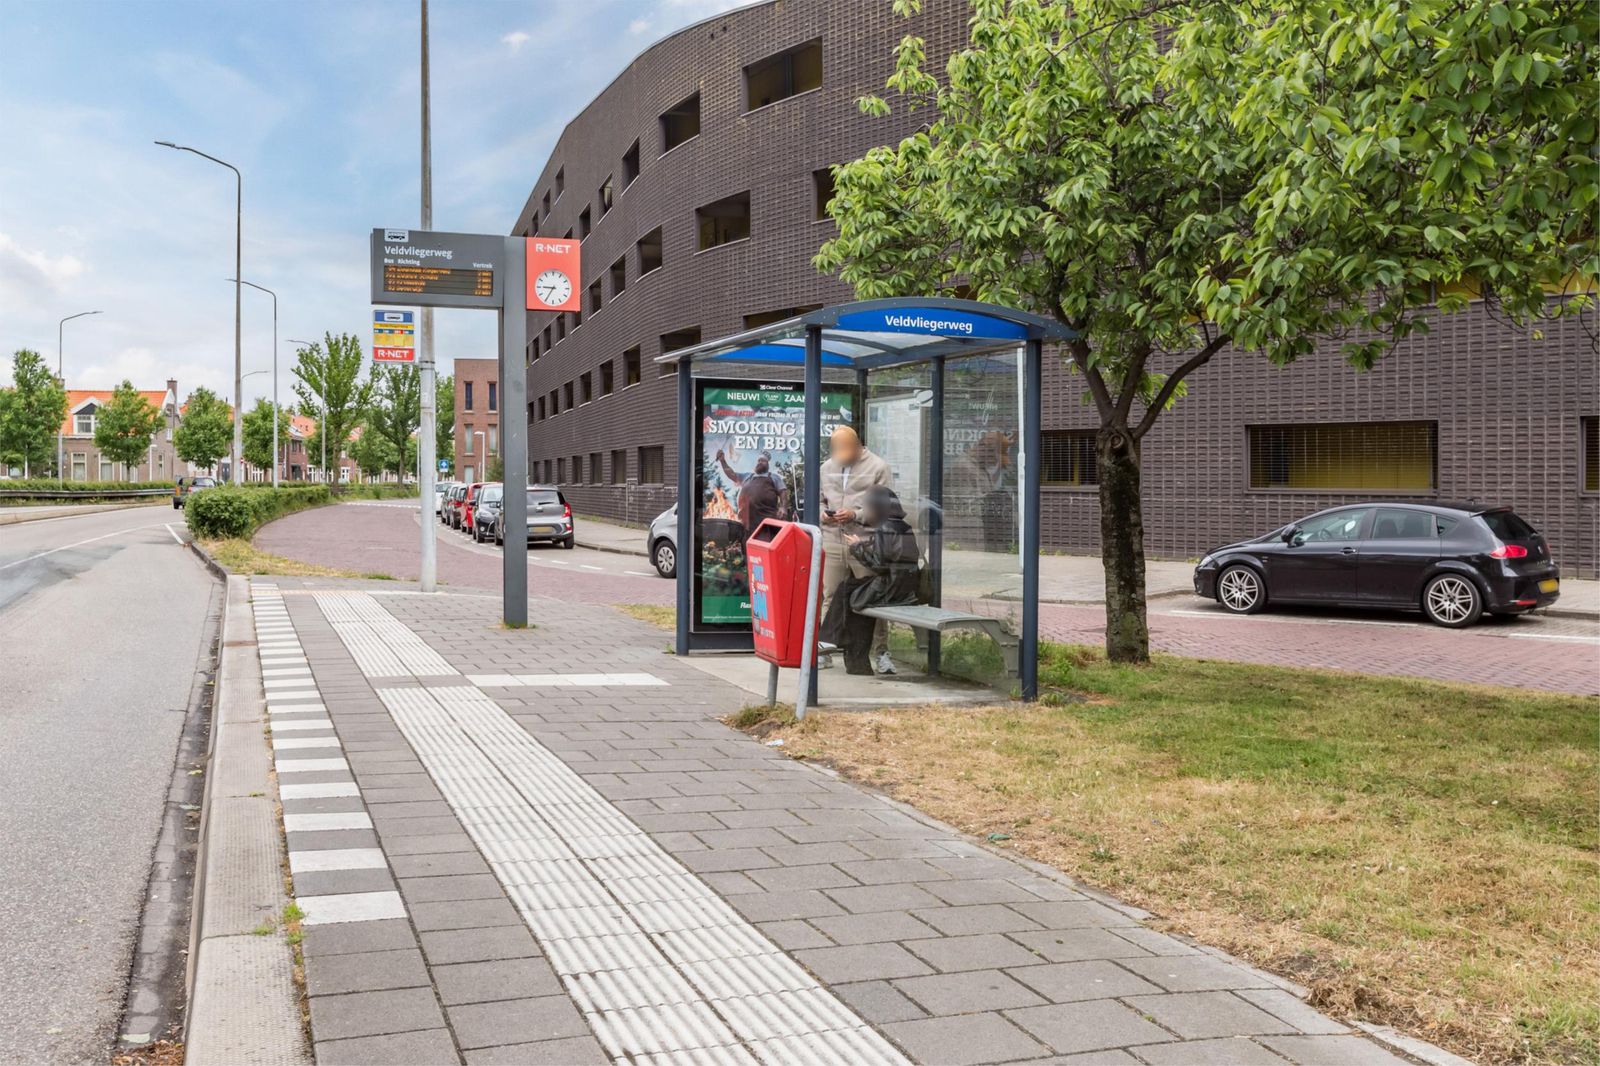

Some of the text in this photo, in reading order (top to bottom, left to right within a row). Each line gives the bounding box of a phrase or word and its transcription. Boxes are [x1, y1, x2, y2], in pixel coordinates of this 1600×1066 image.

[384, 245, 453, 260] Veldvliegerweg
[885, 315, 973, 333] Veldvliegerweg
[727, 392, 760, 401] NIEUW!
[784, 394, 828, 404] ZAAM
[708, 420, 796, 436] SMOKING
[734, 436, 759, 450] EN
